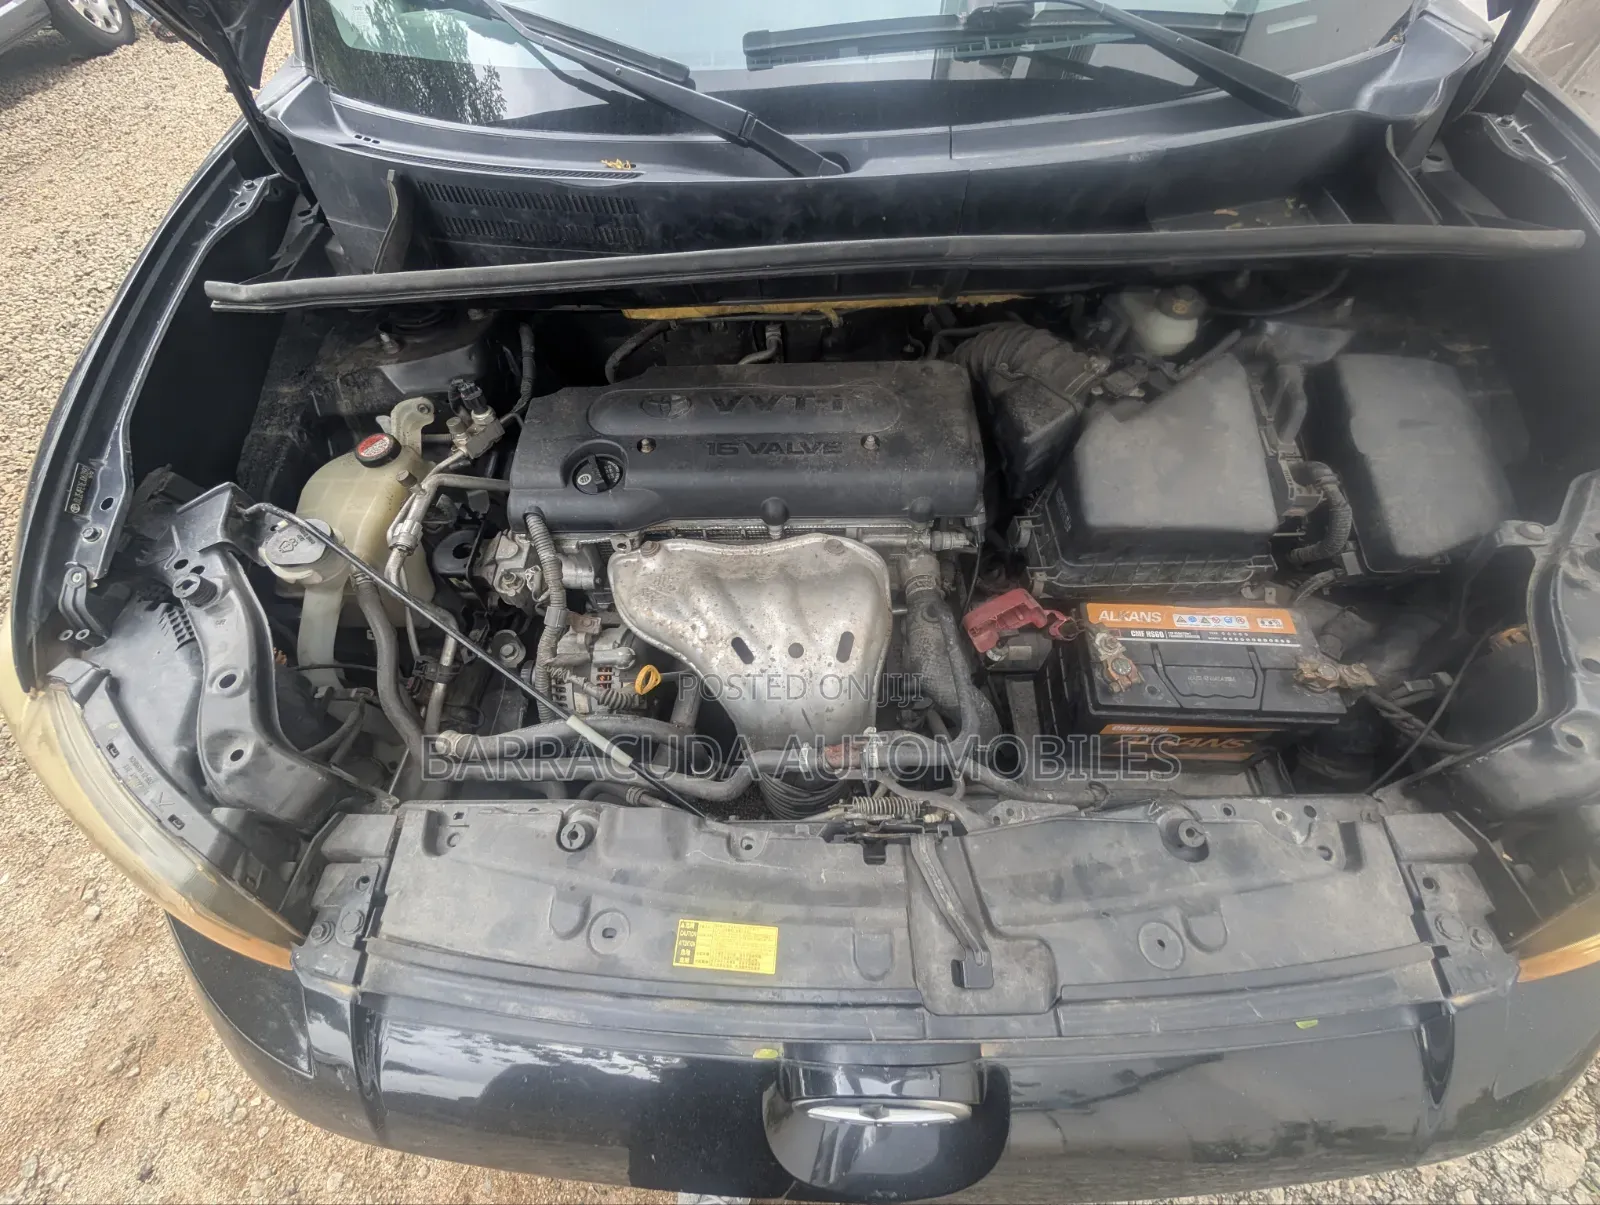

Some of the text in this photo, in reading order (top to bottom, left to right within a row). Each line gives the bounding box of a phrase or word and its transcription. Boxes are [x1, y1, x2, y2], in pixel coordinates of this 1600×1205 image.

[707, 442, 842, 456] 16 VALVE
[1099, 610, 1162, 623] ALKANS
